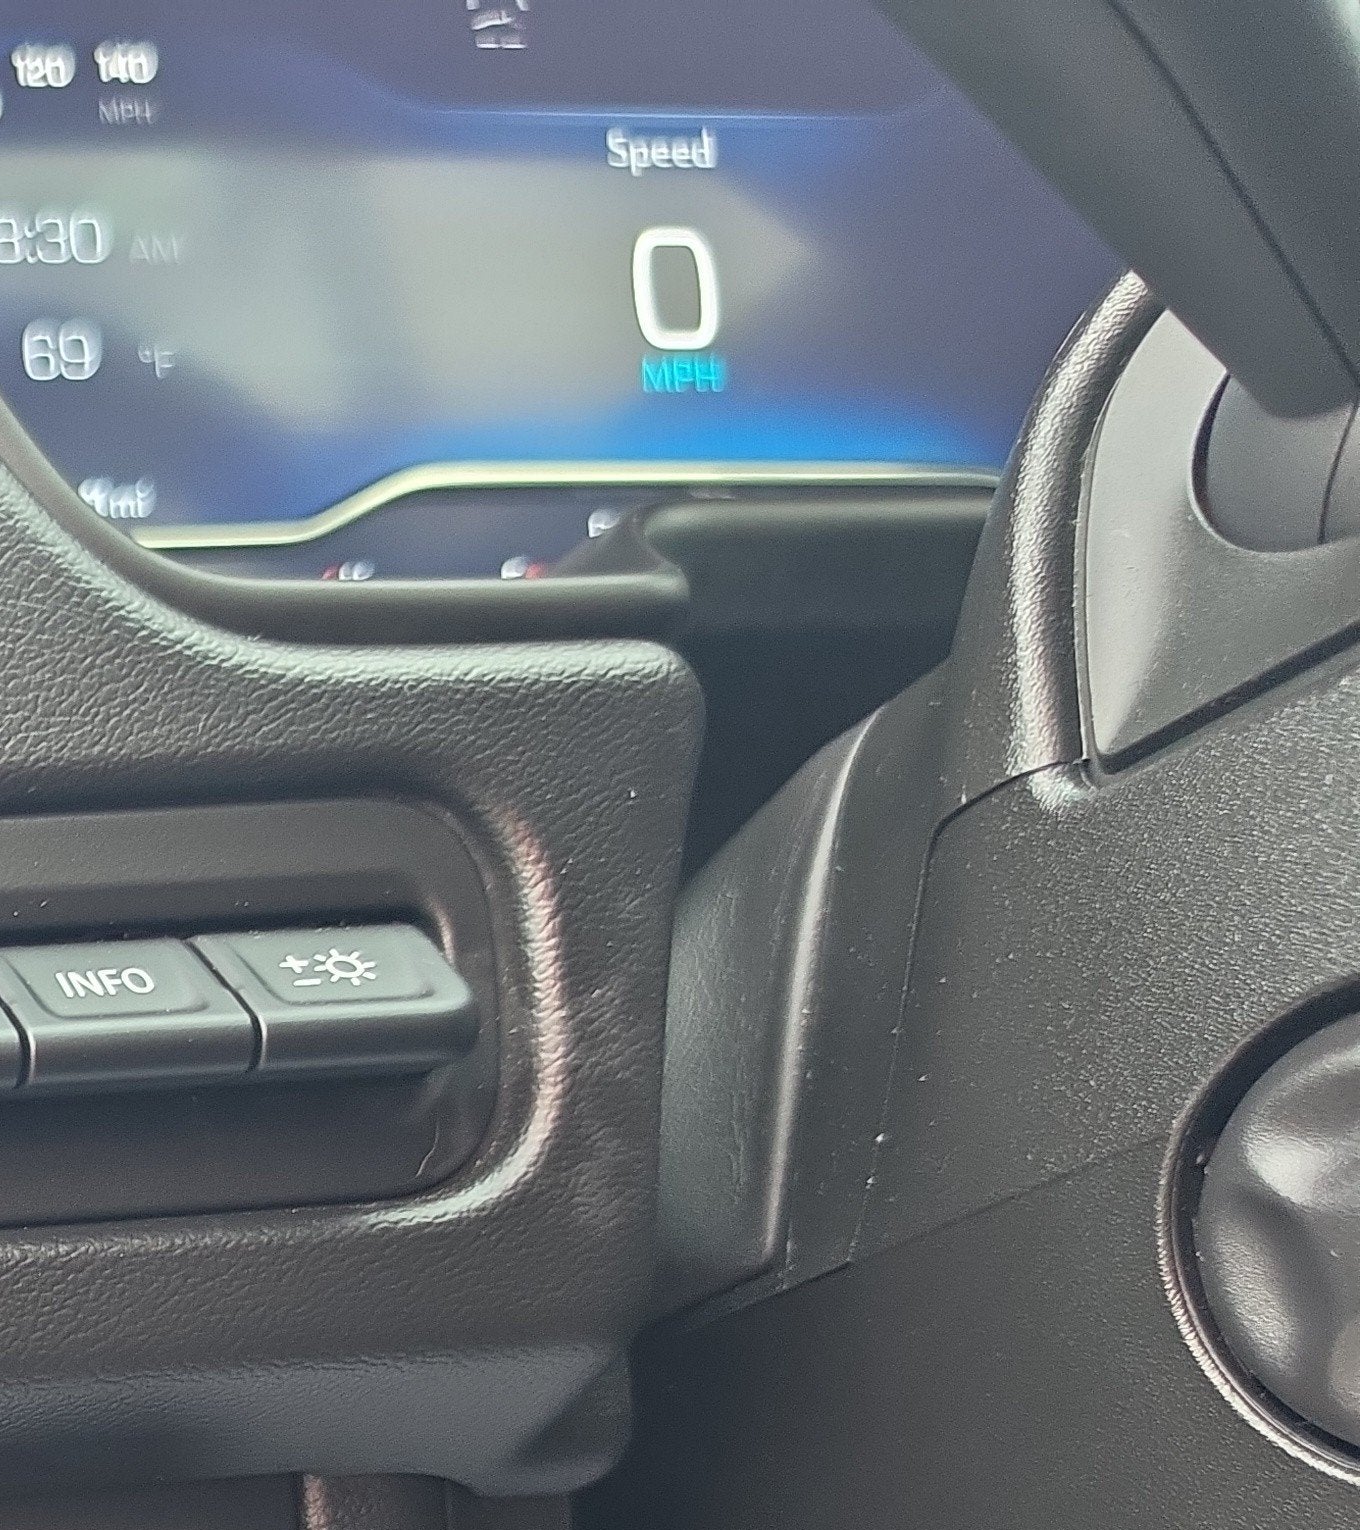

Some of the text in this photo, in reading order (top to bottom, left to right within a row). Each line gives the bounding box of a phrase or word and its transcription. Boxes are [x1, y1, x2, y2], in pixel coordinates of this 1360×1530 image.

[12, 44, 76, 88] 120
[94, 41, 159, 84] 140
[606, 127, 718, 176] Speed
[631, 226, 721, 351] 0
[22, 318, 103, 381] 69
[642, 354, 726, 393] MPH
[54, 967, 155, 998] INFO
